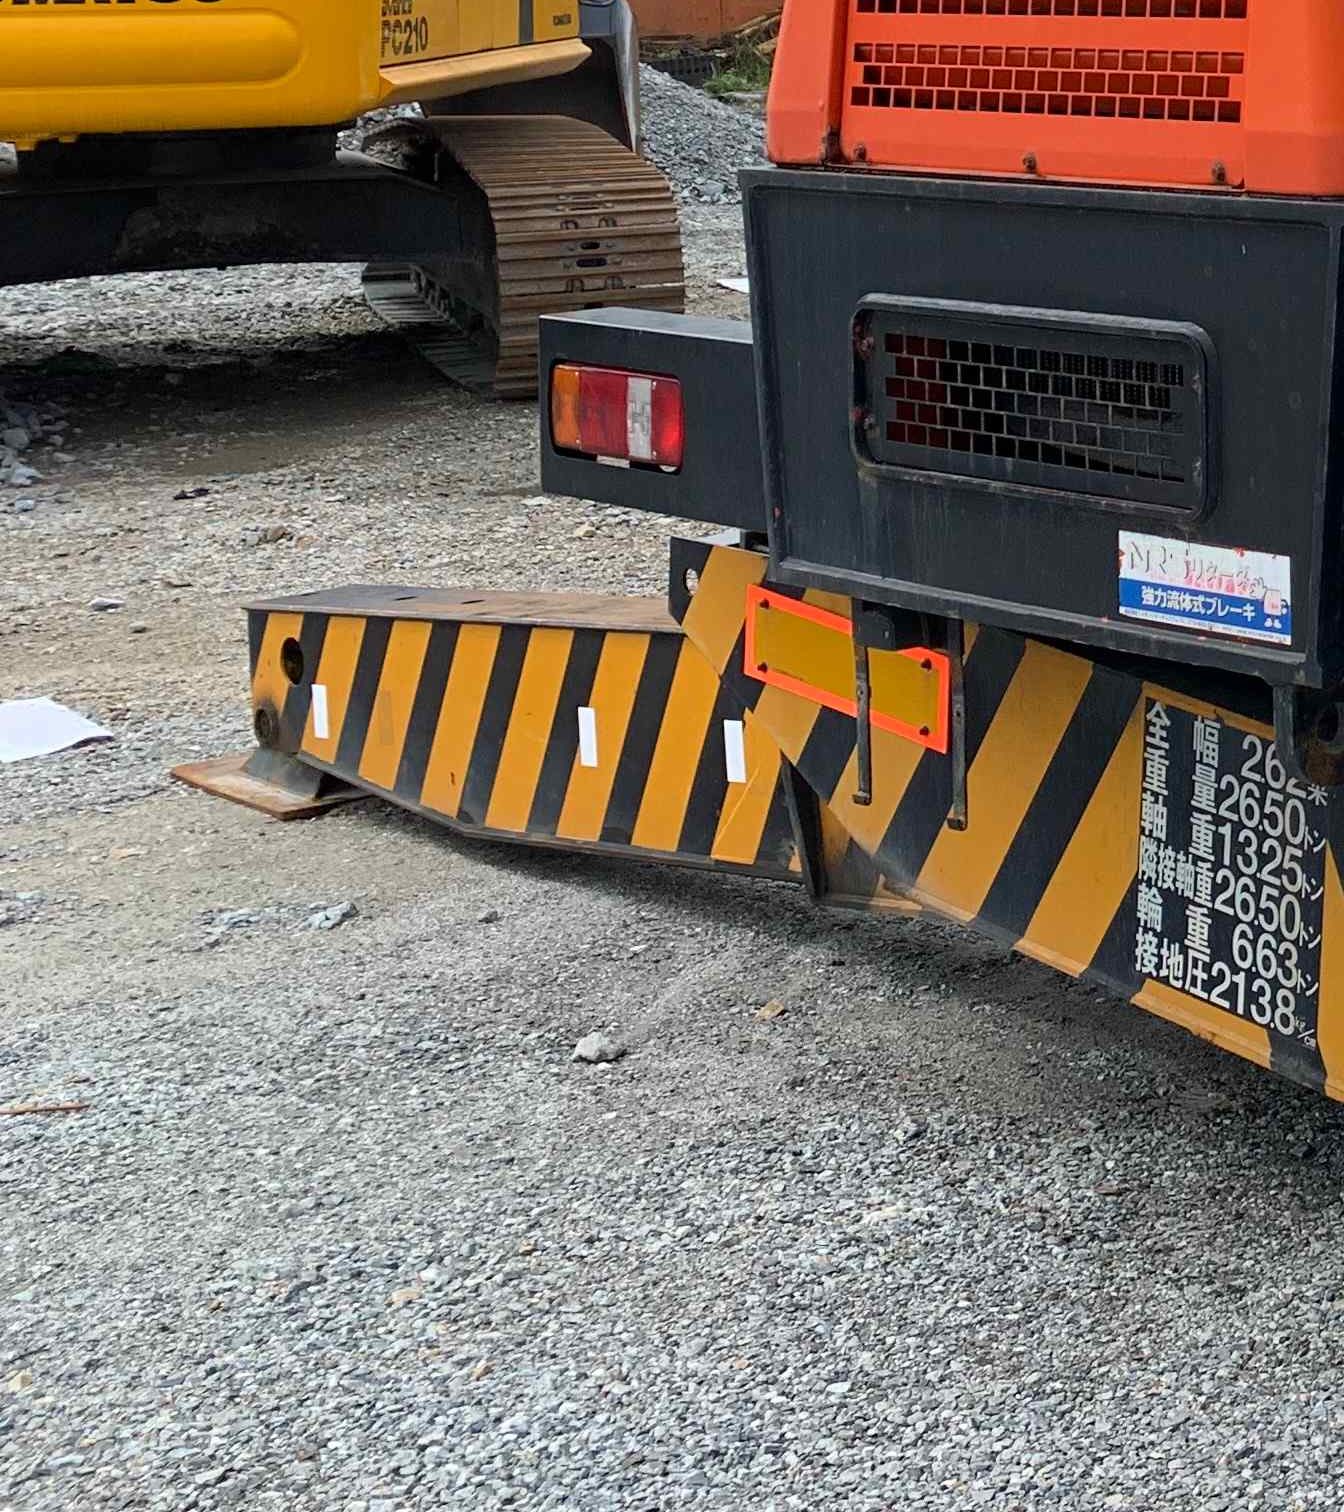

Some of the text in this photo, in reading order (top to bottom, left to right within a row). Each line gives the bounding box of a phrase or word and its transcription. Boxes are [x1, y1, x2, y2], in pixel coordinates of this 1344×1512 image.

[381, 15, 429, 58] PC210
[1141, 584, 1257, 623] 強力流体式ブレーキ
